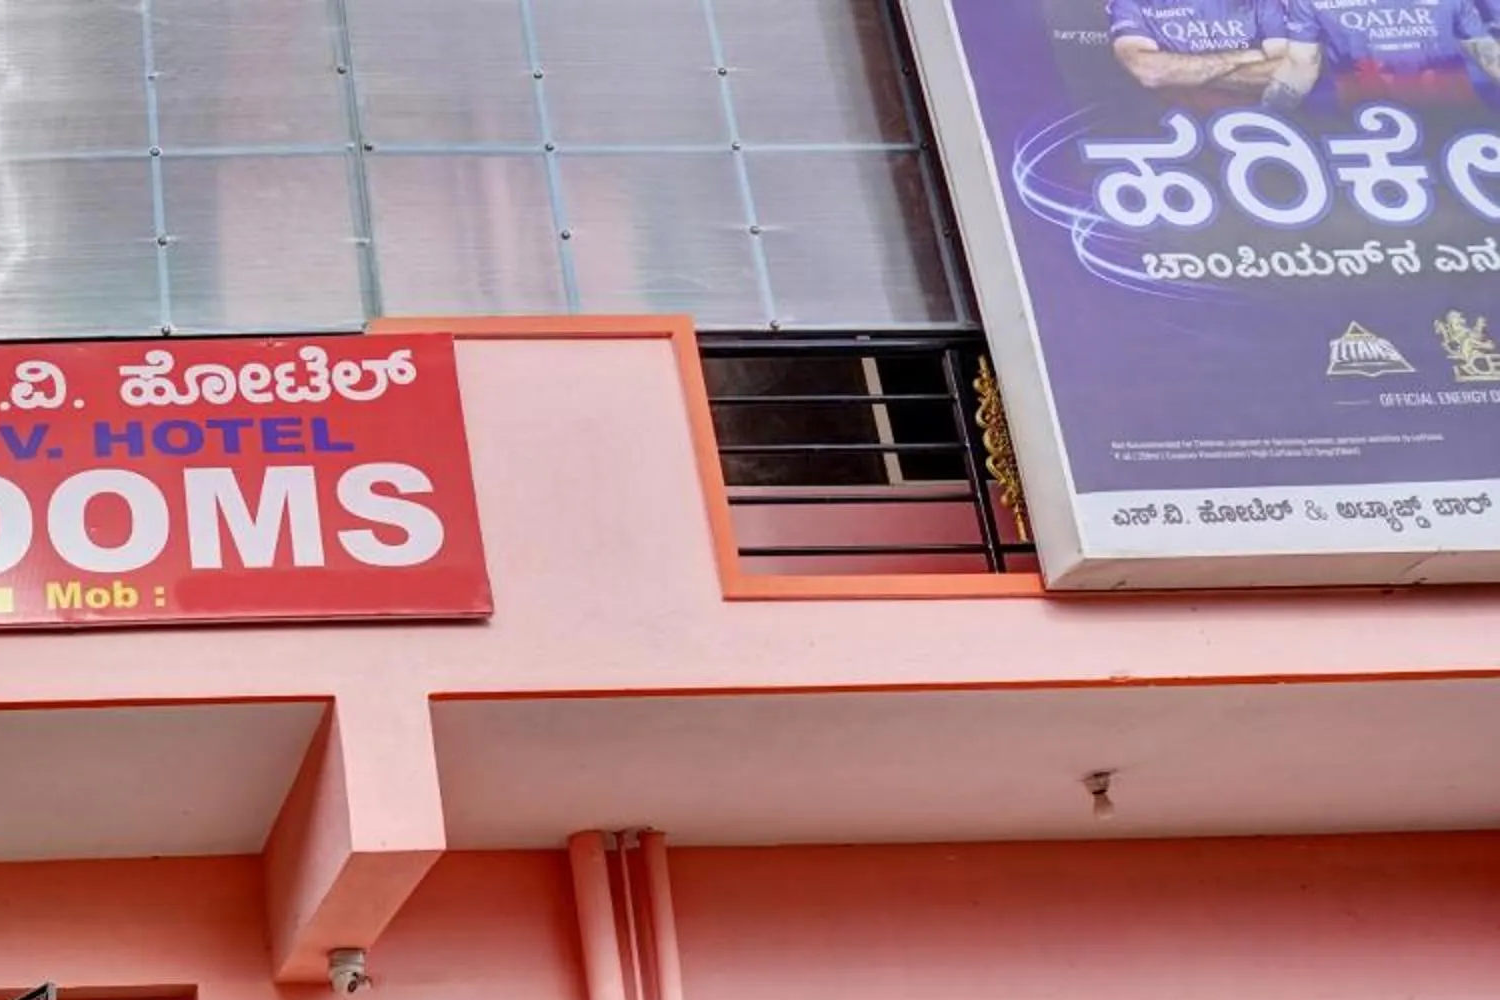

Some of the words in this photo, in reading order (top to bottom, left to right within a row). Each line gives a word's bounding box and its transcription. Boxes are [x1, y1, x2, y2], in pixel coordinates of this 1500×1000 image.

[1341, 8, 1432, 31] QATAR
[118, 345, 417, 407] ಹೋಟೆಲ್
[95, 416, 355, 457] HOTEL
[1199, 497, 1293, 524] ಹೋಟೆಲ್
[1304, 499, 1327, 521] &
[46, 582, 139, 610] Mob
